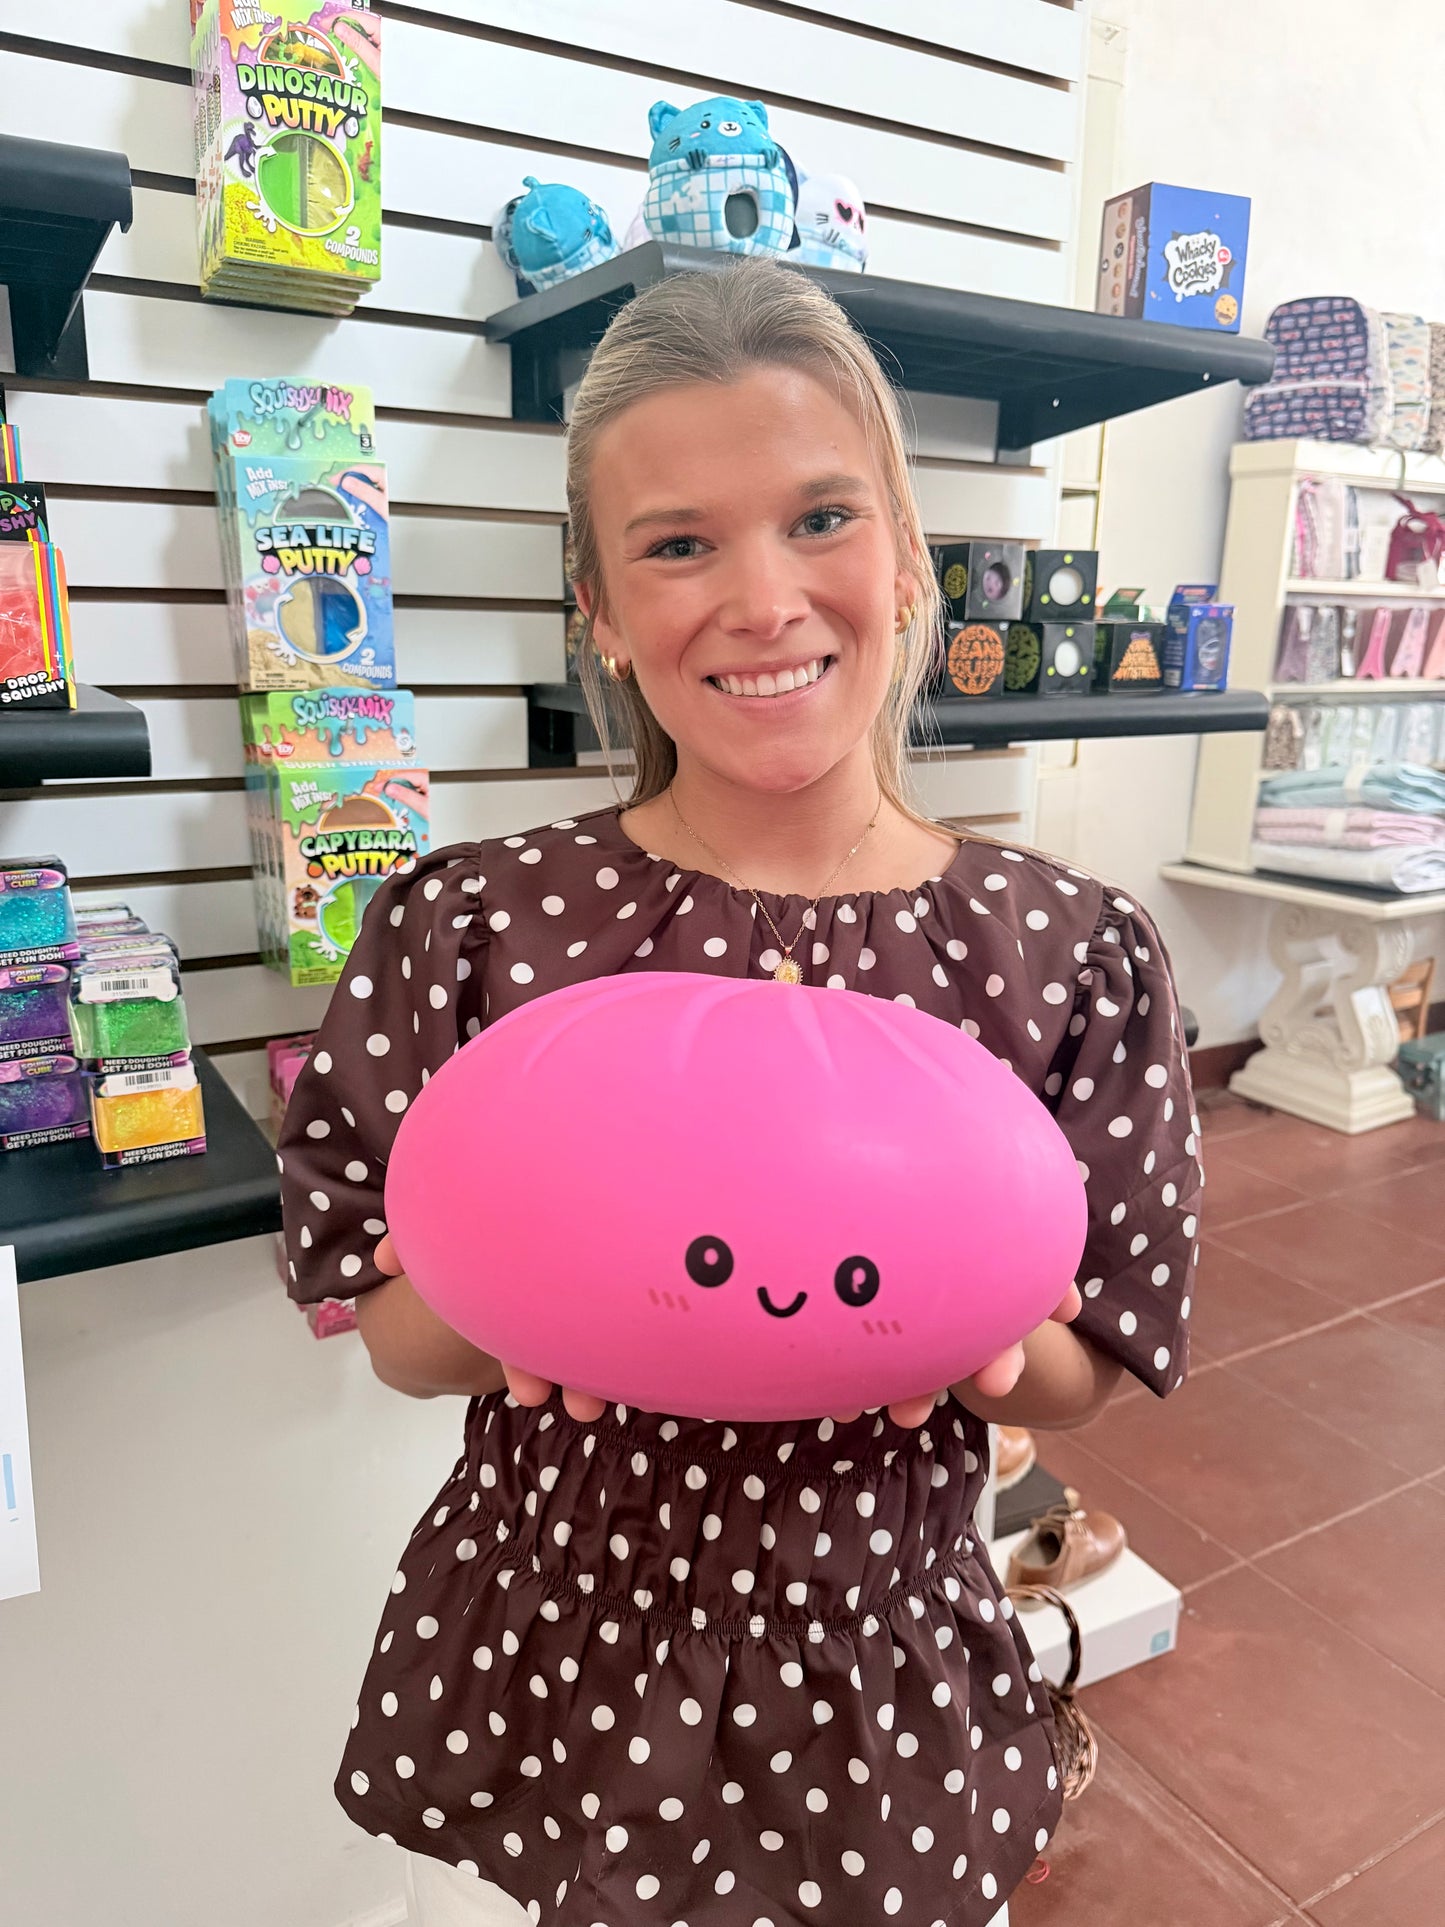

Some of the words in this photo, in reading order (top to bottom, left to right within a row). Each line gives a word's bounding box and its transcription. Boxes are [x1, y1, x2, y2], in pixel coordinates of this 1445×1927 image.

[237, 64, 368, 115] DINOSAUR
[261, 93, 347, 137] PUTTY
[345, 226, 361, 246] 2
[325, 239, 378, 265] COMPOUNDS
[1175, 238, 1217, 262] Whacky
[1173, 260, 1217, 287] Cookies
[245, 467, 273, 481] Add
[255, 526, 311, 551] SEA
[316, 526, 376, 554] LIFE
[277, 549, 357, 576] PUTTY
[361, 648, 376, 664] 2
[342, 663, 393, 680] COMPOUNDS
[7, 671, 48, 690] DROP
[1, 679, 65, 703] SQUISHY
[300, 830, 417, 858] CAPYBARA
[320, 850, 399, 880] PUTTY
[5, 872, 42, 880] SQUISHY
[11, 879, 38, 888] CUBE
[0, 957, 13, 966] ET
[16, 955, 36, 965] FUN
[38, 952, 65, 961] DOH!
[10, 967, 47, 978] SQUISHY
[15, 974, 42, 984] CUBE
[0, 1043, 20, 1051] NEED
[17, 1047, 38, 1056] FUN
[41, 1043, 66, 1053] DOH!
[21, 1059, 57, 1069] SQUISHY
[26, 1065, 52, 1076] CUBE
[102, 1065, 121, 1073] GET
[124, 1063, 145, 1072] FUN
[148, 1061, 173, 1069] DOH!
[6, 1141, 26, 1149] GET
[28, 1137, 48, 1146] FUN
[50, 1132, 75, 1142] DOH!
[9, 1134, 30, 1142] NEED
[121, 1156, 140, 1165] GET
[142, 1152, 164, 1161] FUN
[165, 1147, 191, 1157] DOH!
[124, 1149, 145, 1157] NEED
